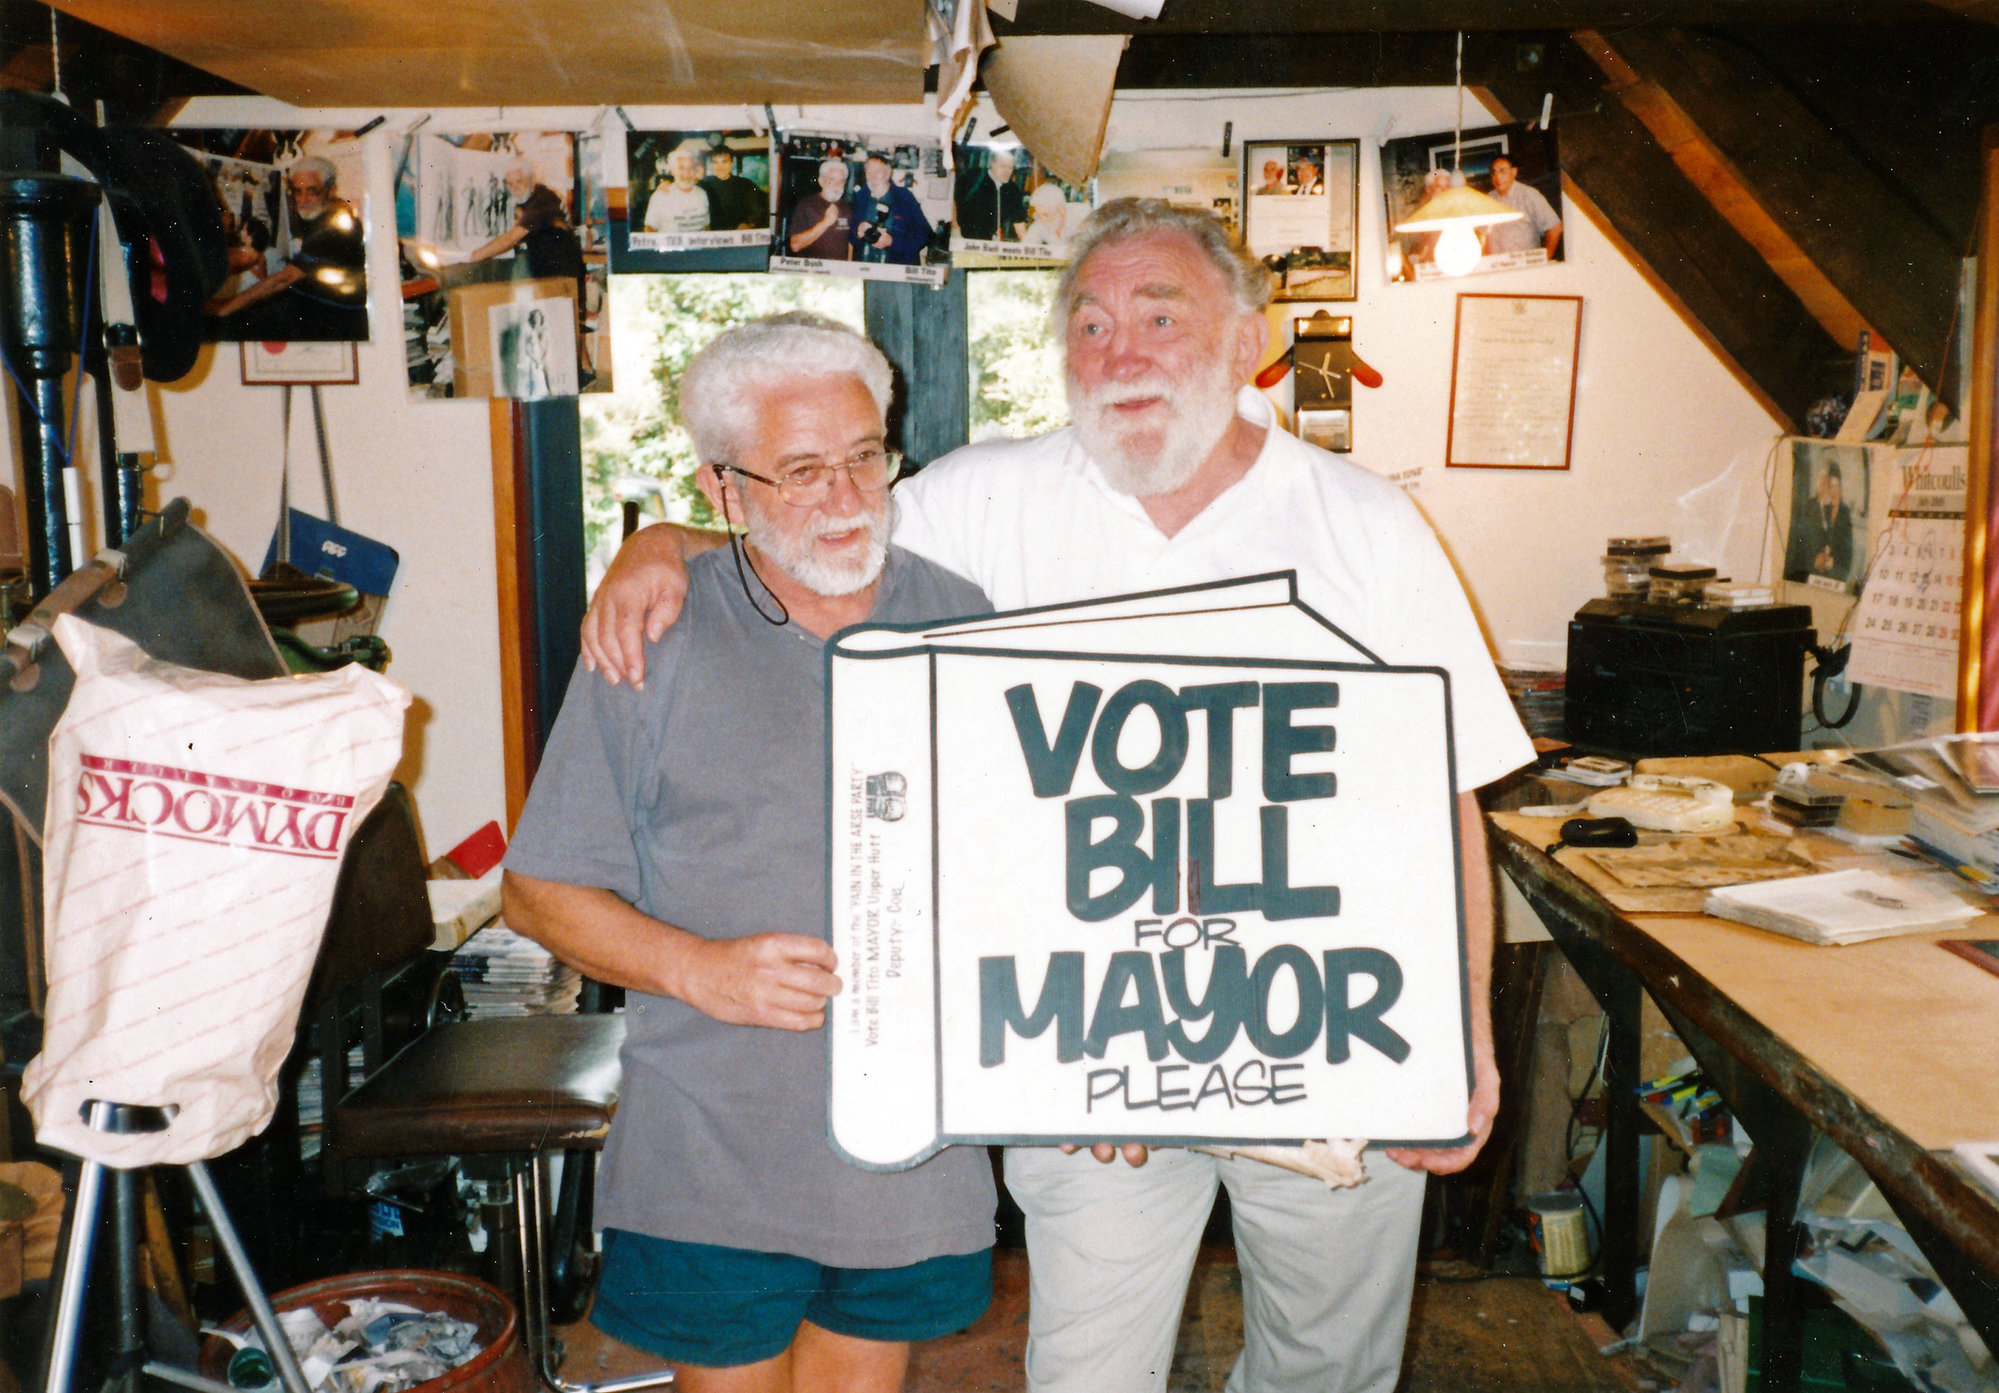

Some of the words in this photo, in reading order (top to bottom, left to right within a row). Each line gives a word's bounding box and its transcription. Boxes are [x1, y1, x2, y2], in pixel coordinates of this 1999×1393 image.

[780, 257, 800, 266] Peter
[804, 259, 823, 267] Bush
[905, 266, 918, 274] Bill
[921, 267, 937, 275] Tito
[1865, 617, 1876, 628] 24
[1881, 618, 1892, 631] 25
[1004, 679, 1340, 802] VOTE
[77, 770, 348, 852] DYMOCKS
[850, 809, 862, 838] ARSE
[850, 842, 862, 860] THE
[867, 834, 880, 863] Hutt
[1065, 794, 1341, 922] BILL
[850, 865, 861, 876] IN
[866, 869, 882, 904] Upper
[866, 910, 880, 960] MAYOR
[1135, 918, 1241, 950] FOR
[850, 952, 861, 994] member
[866, 966, 880, 990] Tito
[865, 996, 879, 1014] Bill
[979, 944, 1412, 1069] MAYOR
[865, 1019, 879, 1047] Vote
[1086, 1060, 1308, 1114] PLEASE
